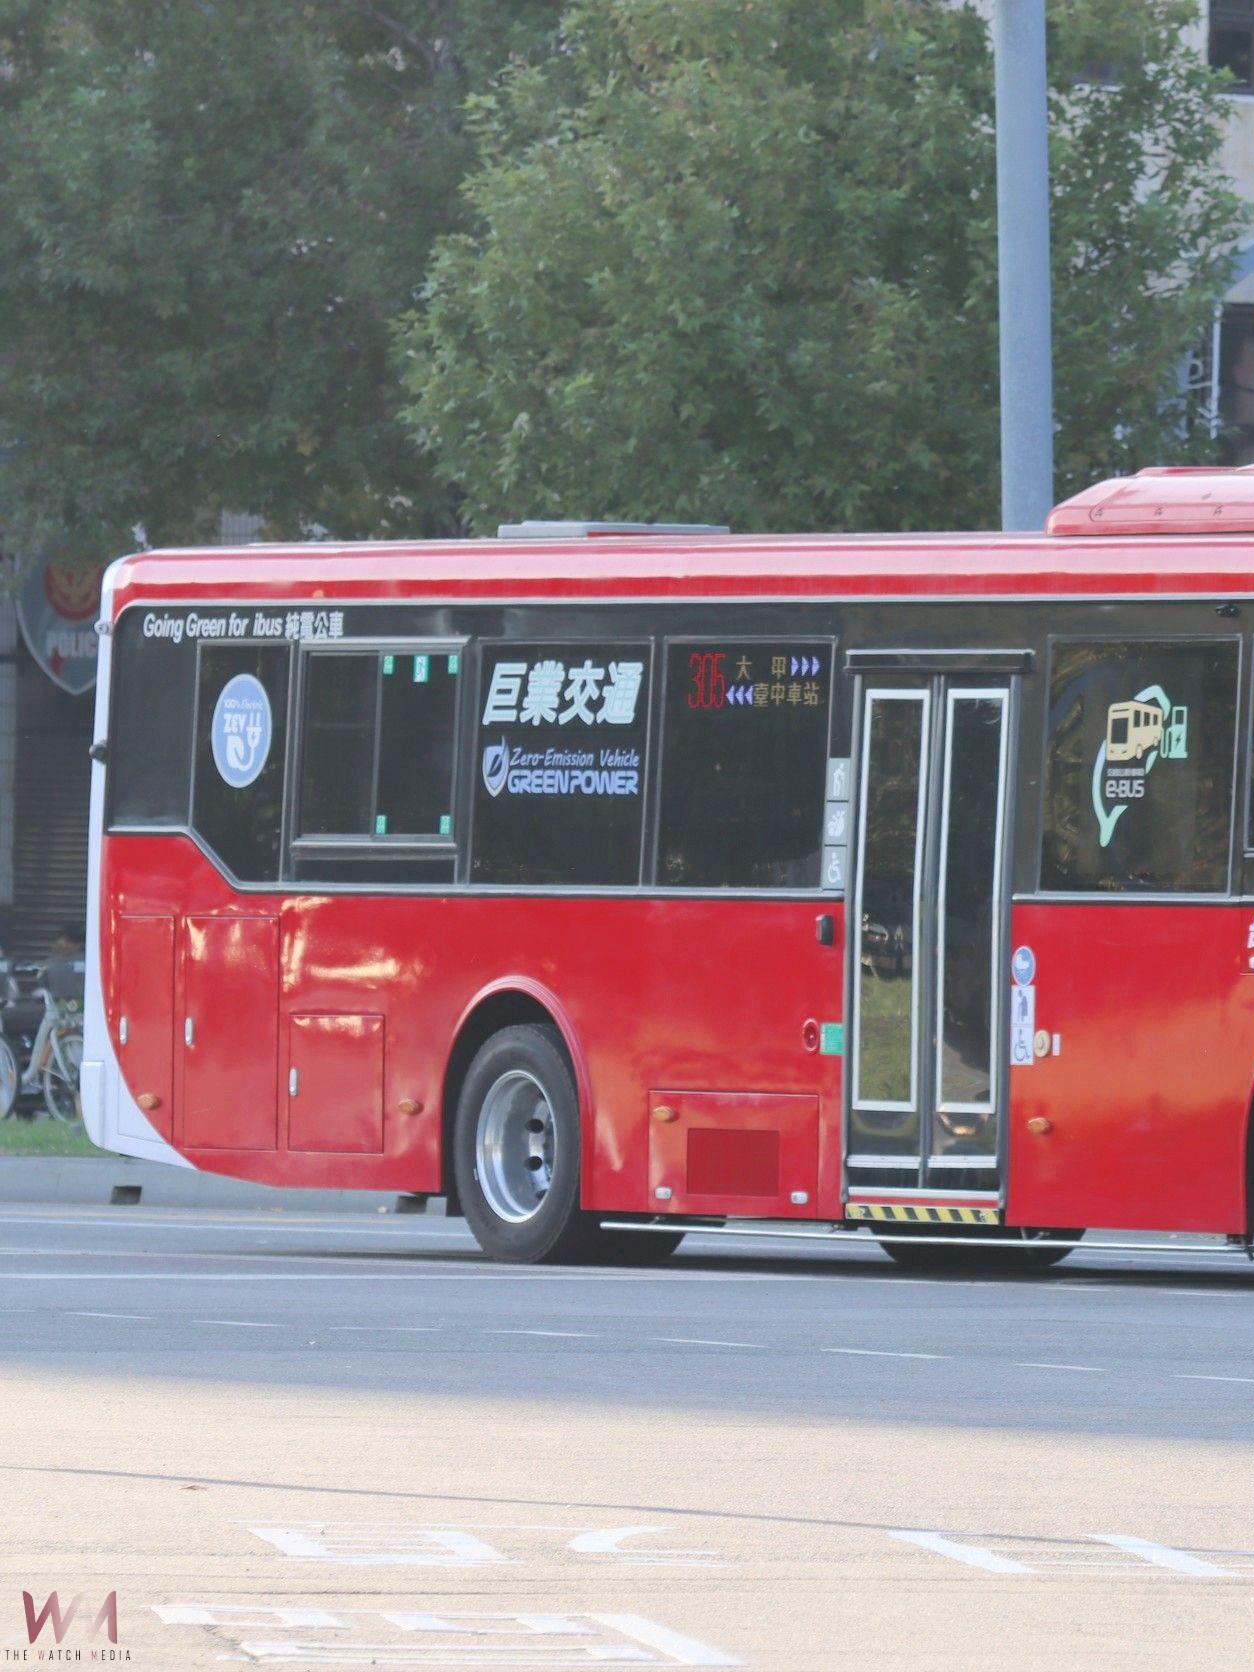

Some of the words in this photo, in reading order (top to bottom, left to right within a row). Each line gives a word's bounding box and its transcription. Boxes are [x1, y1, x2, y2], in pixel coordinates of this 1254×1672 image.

[143, 612, 184, 643] Going
[186, 612, 226, 638] Green
[228, 612, 249, 637] for
[253, 612, 283, 637] ibus
[285, 611, 344, 640] 純電公車
[482, 659, 643, 726] 巨業交通
[688, 652, 726, 709] 305
[754, 682, 820, 708] 臺中車站
[510, 747, 594, 767] Zero-Emission
[600, 748, 640, 768] Vehicle
